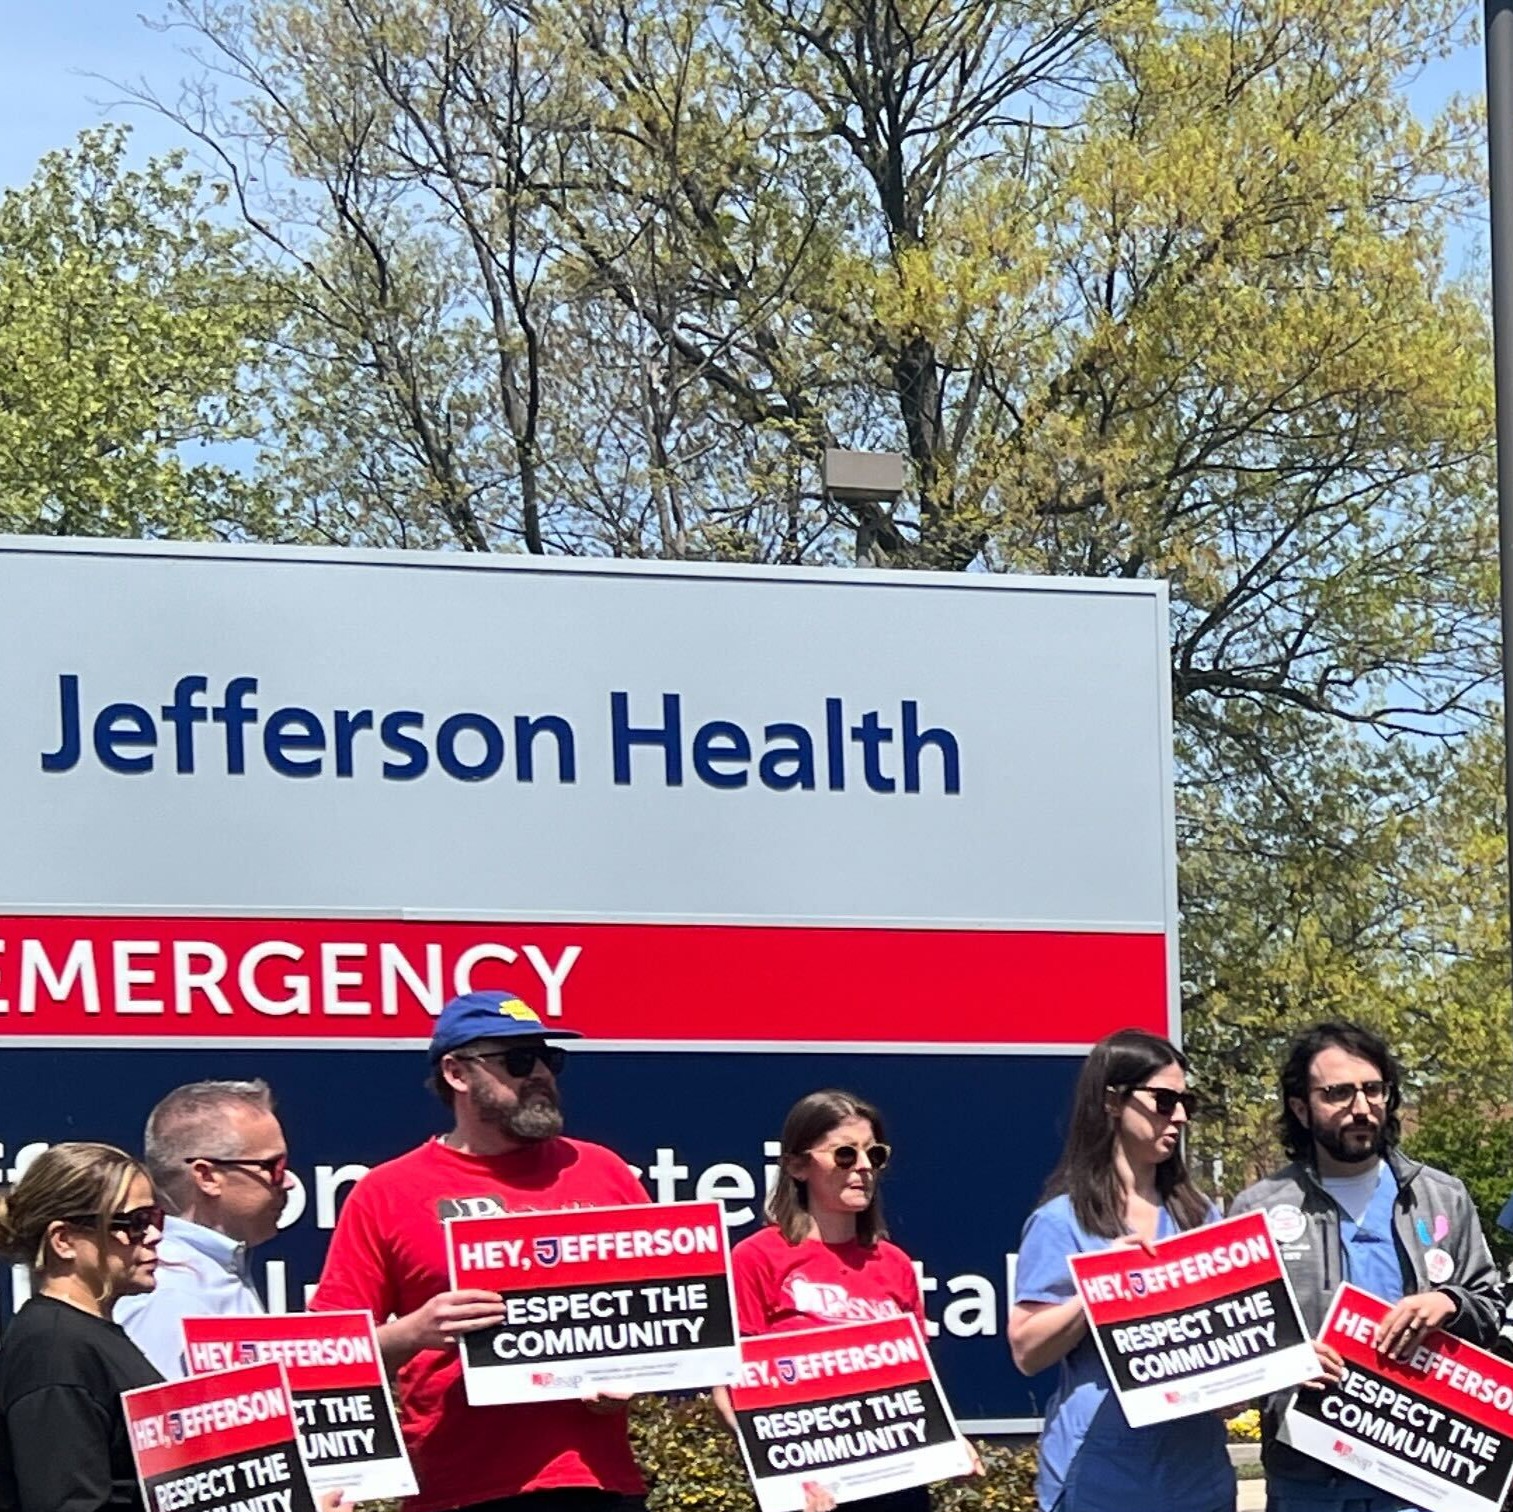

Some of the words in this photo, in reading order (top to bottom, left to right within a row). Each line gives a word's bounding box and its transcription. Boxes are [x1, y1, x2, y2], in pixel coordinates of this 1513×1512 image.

[40, 673, 577, 783] Jefferson
[609, 691, 961, 795] Health
[0, 938, 583, 1018] MERGENCY
[460, 1239, 531, 1272] HEY,
[534, 1225, 718, 1268] JEFFERSON
[1082, 1273, 1132, 1302] HEY,
[1129, 1234, 1270, 1299] JEFFERSON
[504, 1289, 634, 1326] ESPECT
[641, 1284, 709, 1314] THE
[1111, 1309, 1214, 1355] RESPECT
[1215, 1291, 1275, 1328] THE
[238, 1336, 374, 1367] JEFFERSON
[492, 1316, 705, 1360] COMMUNITY
[730, 1361, 780, 1389] HEY,
[777, 1337, 921, 1383] JEFFERSON
[1128, 1321, 1277, 1383] COMMUNITY
[133, 1413, 171, 1450] HEY,
[167, 1386, 287, 1445] JEFFERSON
[320, 1394, 375, 1424] THE
[752, 1401, 863, 1440] RESPECT
[866, 1389, 926, 1421] THE
[299, 1428, 375, 1460] UNITY
[766, 1418, 927, 1470] COMMUNITY
[1320, 1395, 1487, 1485] COMMUNITY
[1448, 1418, 1501, 1462] THE
[239, 1452, 291, 1489] THE
